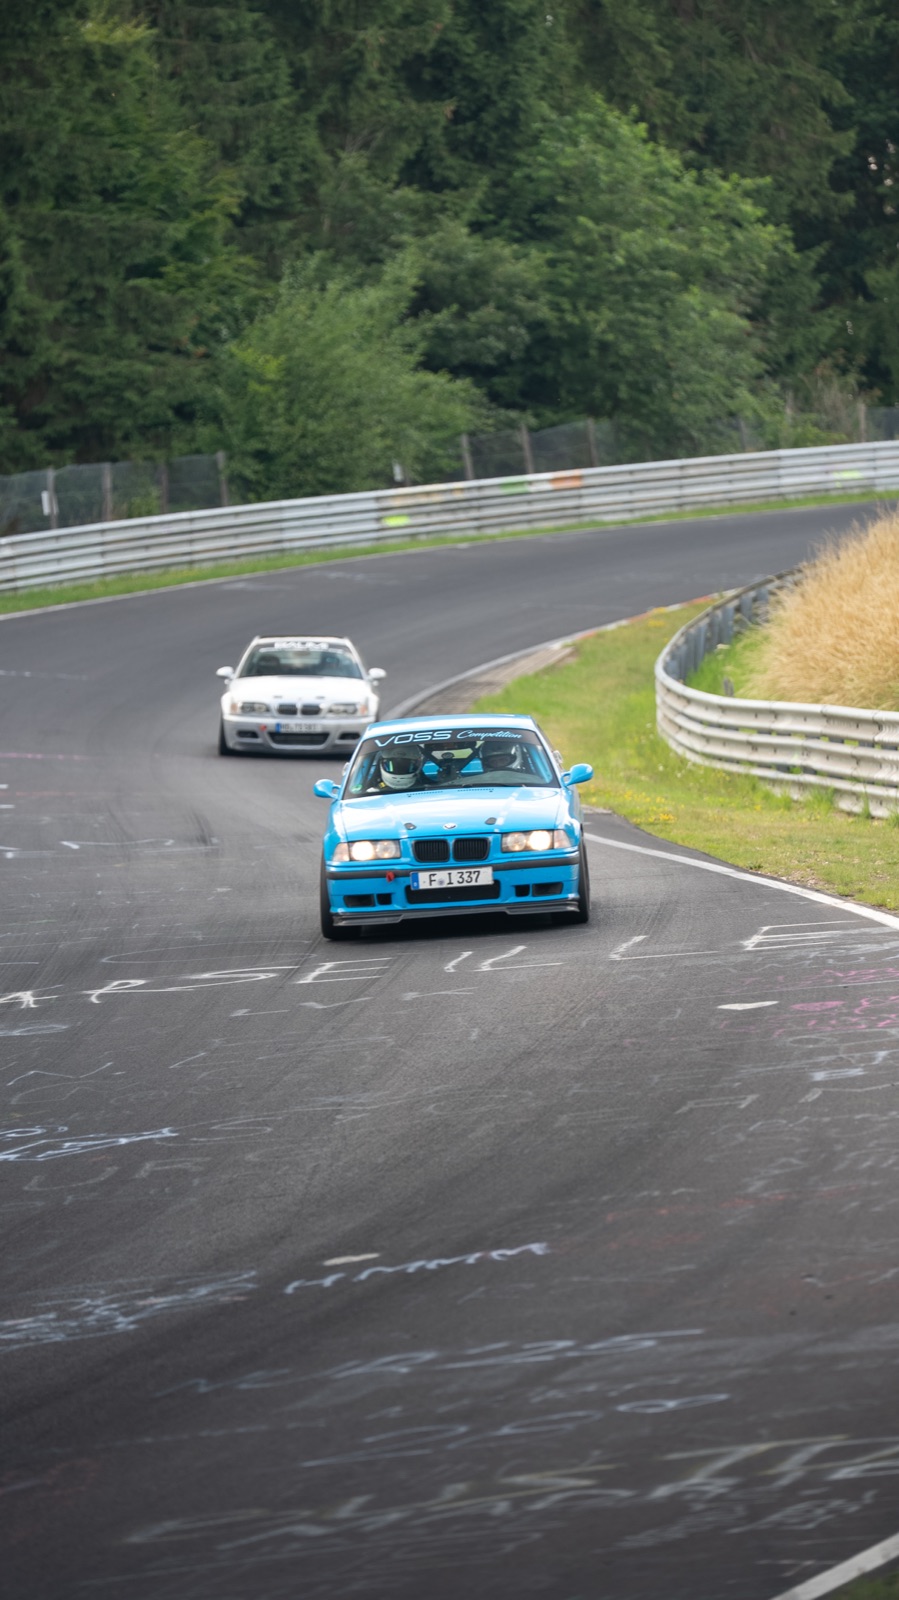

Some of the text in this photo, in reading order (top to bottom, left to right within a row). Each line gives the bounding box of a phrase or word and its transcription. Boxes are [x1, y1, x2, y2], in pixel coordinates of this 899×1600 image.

[375, 729, 522, 747] VOSS Competition
[428, 873, 438, 886] F
[457, 870, 481, 884] 337
